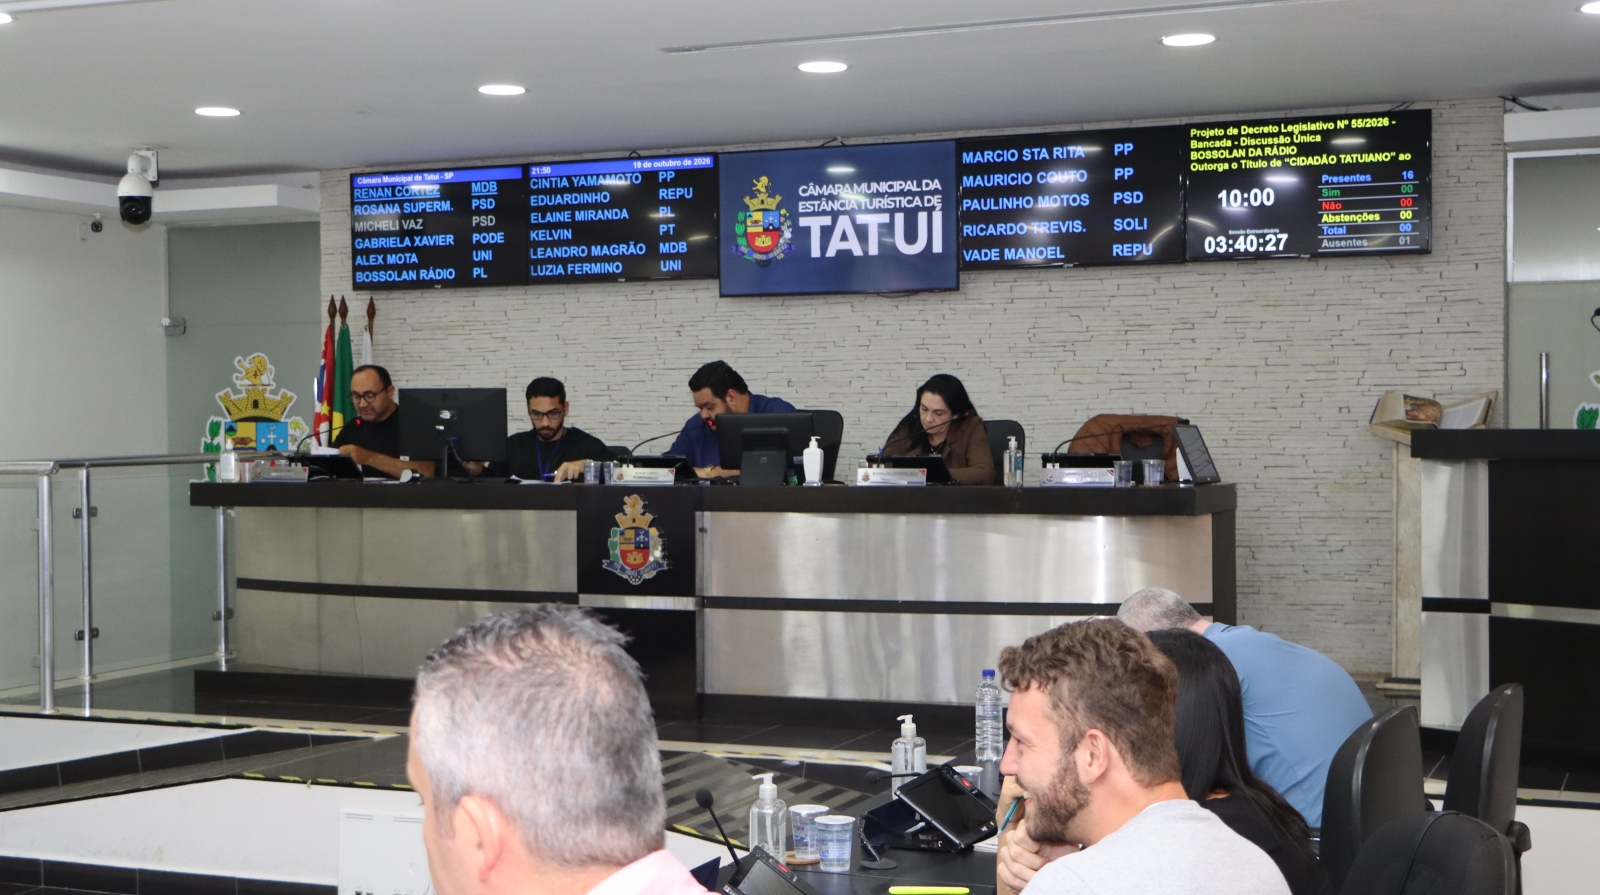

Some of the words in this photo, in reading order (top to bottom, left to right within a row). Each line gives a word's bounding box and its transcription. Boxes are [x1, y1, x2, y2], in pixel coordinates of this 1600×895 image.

[1191, 128, 1225, 137] Projeto
[1241, 125, 1279, 134] Decreto
[1282, 122, 1334, 135] Legislativo
[1351, 118, 1389, 129] 55/2026
[1191, 139, 1231, 148] Bancada
[1240, 136, 1290, 146] Discussão
[1293, 132, 1321, 143] Única
[963, 150, 1018, 164] MARCIO
[1023, 148, 1049, 160] STA
[1053, 146, 1085, 159] RITA
[1114, 143, 1134, 156] PP
[1191, 149, 1246, 160] BOSSOLAN
[1248, 148, 1262, 157] DA
[1264, 146, 1297, 156] RÁDIO
[1191, 162, 1229, 172] Outorga
[1270, 158, 1282, 167] de
[383, 175, 413, 183] Municipal
[530, 177, 569, 189] CINTIA
[572, 173, 642, 186] YAMAMOTO
[659, 171, 675, 182] PP
[963, 173, 1033, 188] MAURICIO
[1037, 170, 1087, 184] COUTO
[1114, 168, 1134, 180] PP
[1322, 173, 1372, 183] Presentes
[1402, 171, 1413, 180] 16
[354, 187, 392, 199] RENAN
[395, 185, 440, 197] CORTEZ
[471, 182, 497, 192] MDB
[799, 182, 853, 196] CÂMARA
[853, 181, 921, 194] MUNICIPAL
[922, 179, 942, 191] DA
[1322, 188, 1340, 197] Sim
[1402, 185, 1413, 193] 00
[531, 192, 610, 206] EDUARDINHO
[659, 187, 693, 199] REPU
[799, 198, 858, 212] ESTÂNCIA
[859, 196, 923, 210] TURÍSTICA
[924, 195, 942, 206] DE
[963, 196, 1034, 211] PAULINHO
[1038, 194, 1089, 207] MOTOS
[1113, 192, 1143, 204] PSD
[1218, 188, 1274, 207] 10:00
[1322, 201, 1342, 210] Não
[1401, 198, 1412, 207] 00
[354, 204, 401, 215] ROSANA
[404, 201, 453, 213] SUPERM.
[472, 199, 495, 209] PSD
[531, 211, 571, 223] ELAINE
[575, 209, 629, 221] MIRANDA
[659, 206, 675, 217] PL
[355, 220, 399, 232] MICHELI
[402, 219, 423, 229] VAZ
[473, 216, 495, 226] PSD
[1322, 213, 1380, 223] Abstenções
[1400, 211, 1412, 219] 00
[531, 229, 572, 241] KELVIN
[660, 224, 675, 235] PT
[799, 206, 942, 258] TATUÍ
[963, 222, 1027, 237] RICARDO
[1032, 220, 1086, 234] TREVIS.
[1114, 218, 1148, 231] SOLI
[1322, 226, 1346, 235] Total
[1400, 223, 1411, 232] 00
[355, 237, 411, 249] GABRIELA
[414, 235, 454, 246] XAVIER
[473, 233, 504, 244] PODE
[1205, 234, 1288, 254] 03:40:27
[1322, 238, 1368, 247] Ausentes
[1399, 237, 1410, 245] 01
[355, 254, 383, 265] ALEX
[387, 253, 418, 263] MOTA
[473, 250, 492, 261] UNI
[531, 246, 587, 259] LEANDRO
[591, 242, 646, 256] MAGRÃO
[660, 242, 687, 253] MDB
[963, 249, 999, 262] VADE
[1004, 247, 1065, 260] MANOEL
[1113, 243, 1153, 257] REPU
[356, 271, 416, 282] BOSSOLAN
[420, 267, 455, 280] RÁDIO
[473, 268, 487, 278] PL
[531, 265, 564, 276] LUZIA
[568, 262, 622, 274] FERMINO
[661, 260, 681, 271] UNI
